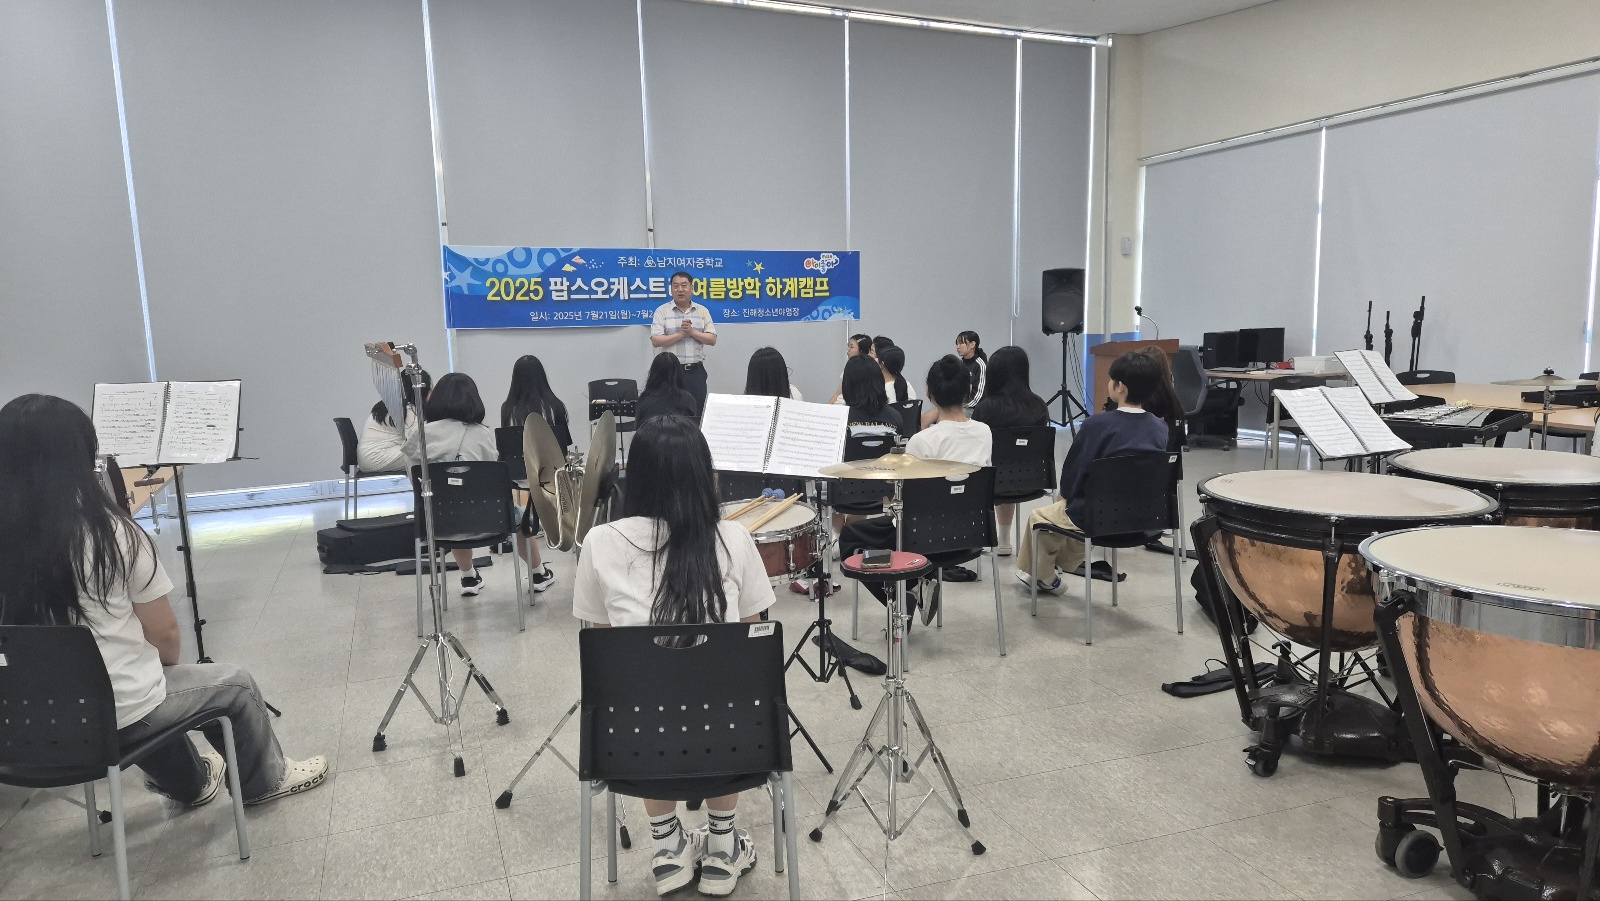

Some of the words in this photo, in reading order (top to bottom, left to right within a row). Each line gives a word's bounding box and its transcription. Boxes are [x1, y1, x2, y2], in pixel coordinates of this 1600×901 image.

[617, 256, 640, 268] 주최:
[656, 257, 724, 269] 남지여자중학교
[485, 277, 544, 301] 2025
[549, 277, 673, 301] 팝스오케스트
[692, 276, 761, 299] 여름방학
[765, 276, 830, 299] 하계캠프
[529, 311, 550, 322] 일시:
[553, 311, 583, 322] 2025년
[585, 309, 654, 321] 7월21일(월)~7월2
[722, 308, 740, 318] 장소:
[742, 307, 800, 318] 진해청소년야영장
[290, 773, 324, 793] crocs
